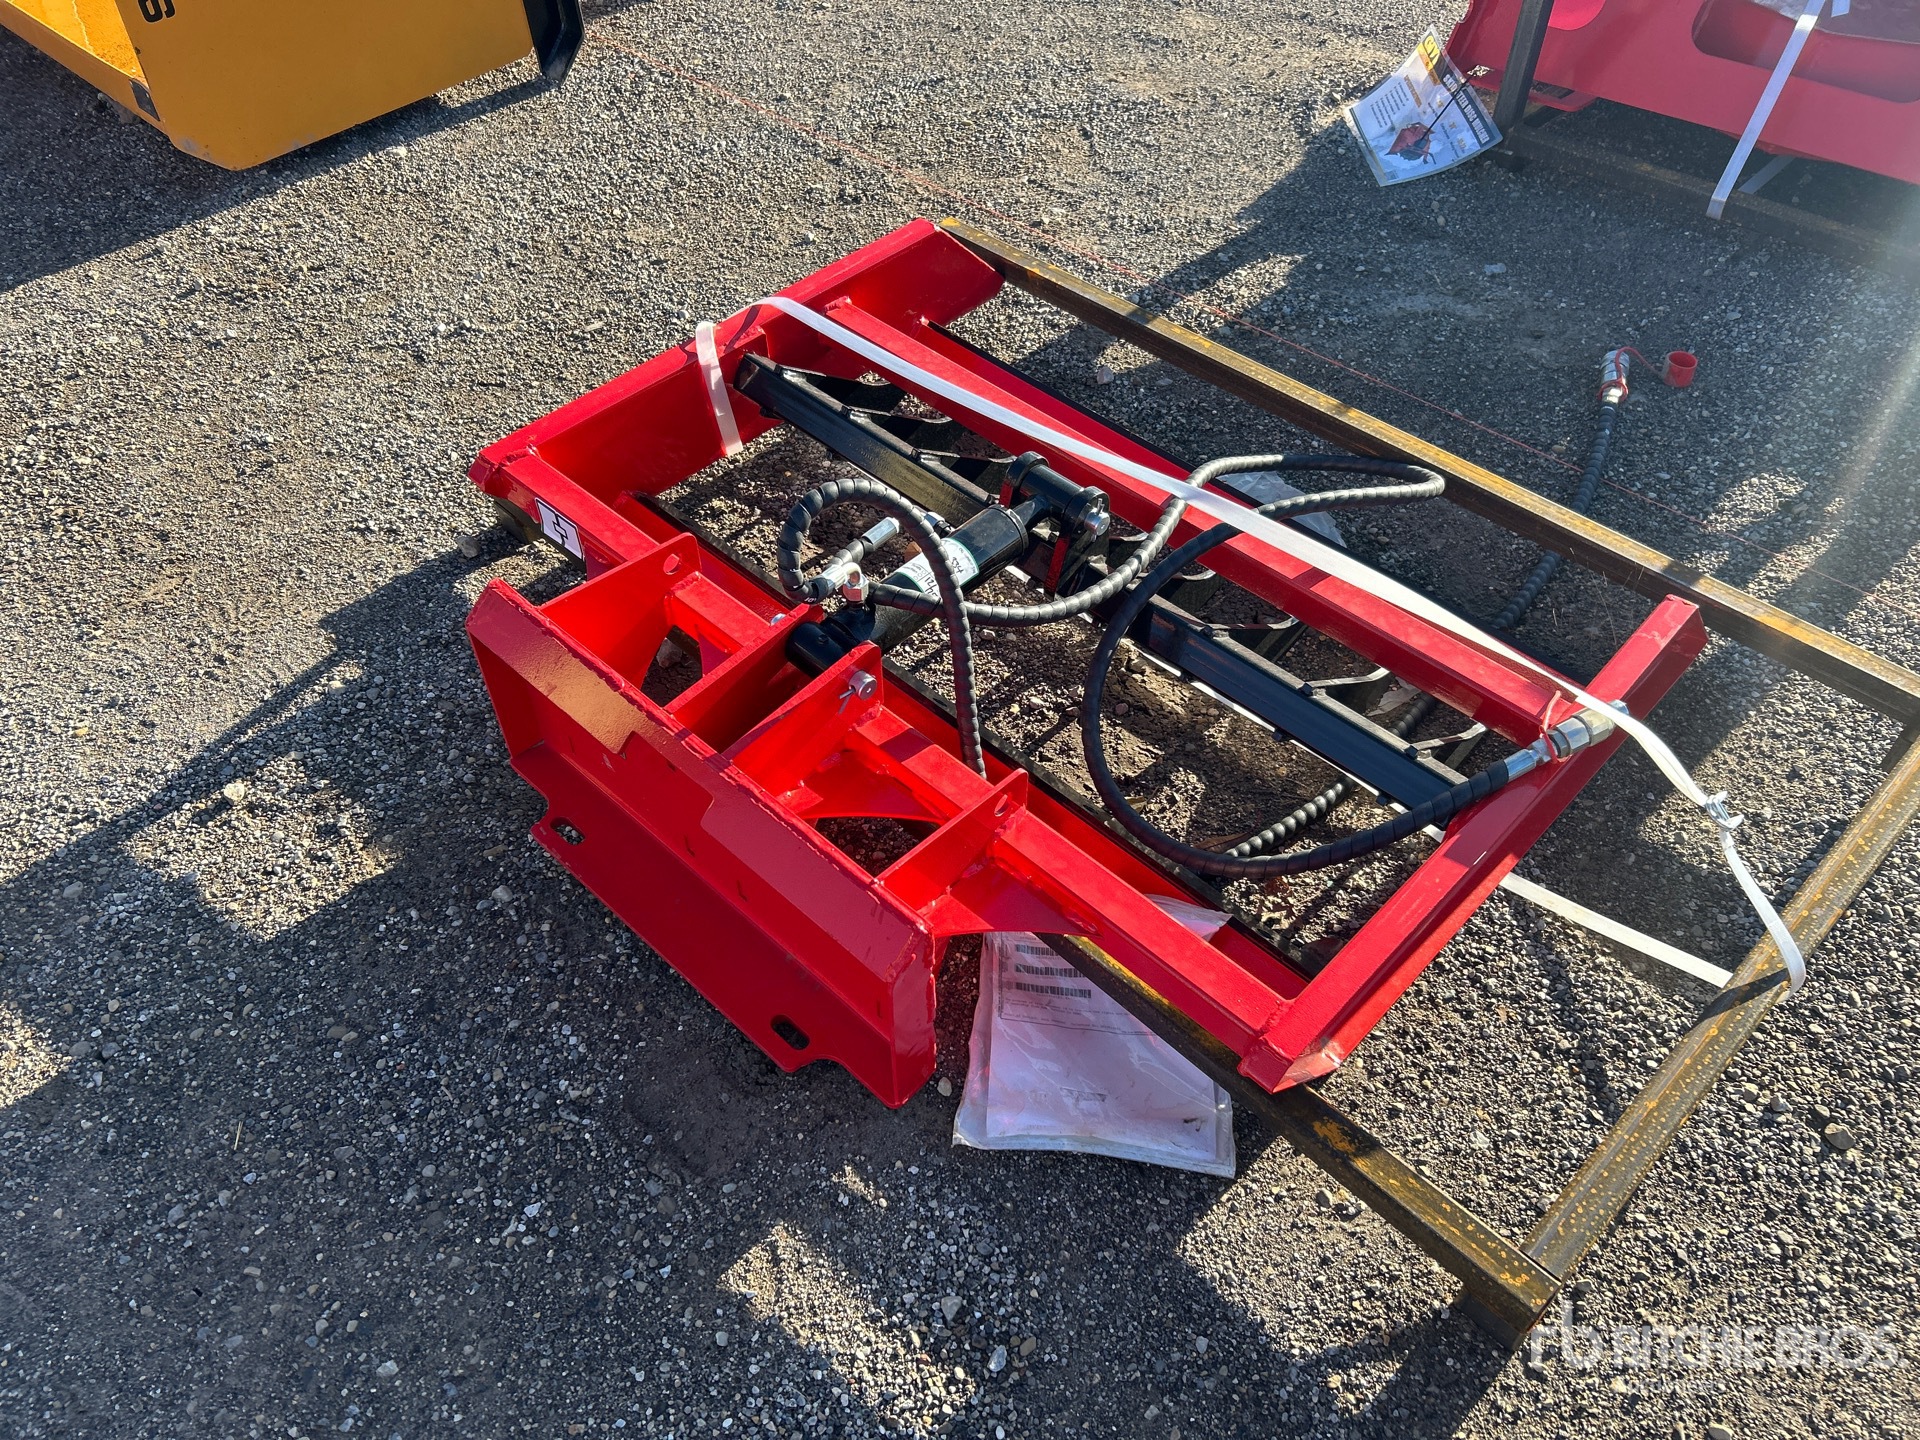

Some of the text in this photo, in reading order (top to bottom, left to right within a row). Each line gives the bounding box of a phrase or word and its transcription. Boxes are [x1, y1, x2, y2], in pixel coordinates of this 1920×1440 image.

[1443, 74, 1458, 92] SKID
[1464, 104, 1477, 122] DISC
[1471, 117, 1490, 144] MULCHER
